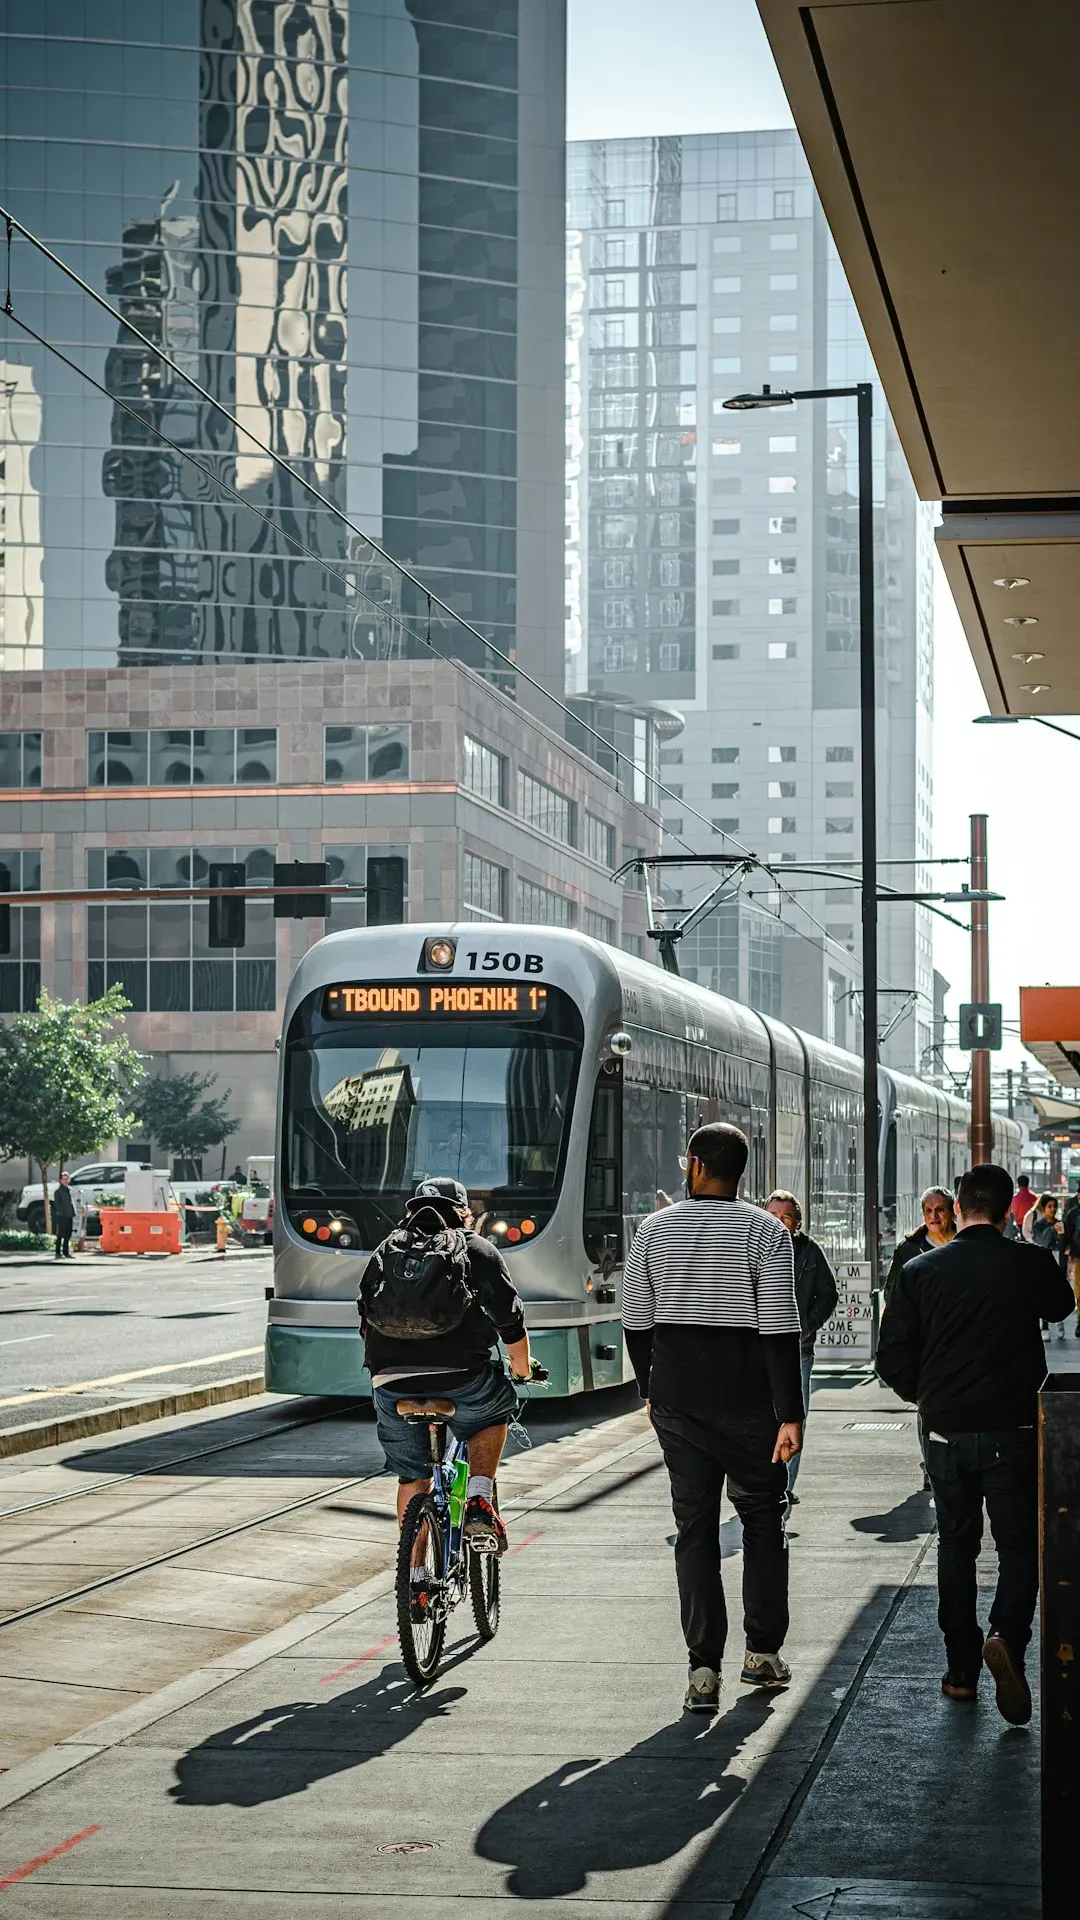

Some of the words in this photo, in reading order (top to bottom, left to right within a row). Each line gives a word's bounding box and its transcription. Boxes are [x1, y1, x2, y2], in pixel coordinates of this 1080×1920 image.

[466, 952, 544, 974] 150B
[342, 988, 420, 1012] TBOUND
[429, 987, 517, 1011] PHOENIX
[820, 1334, 857, 1345] ENJOY
